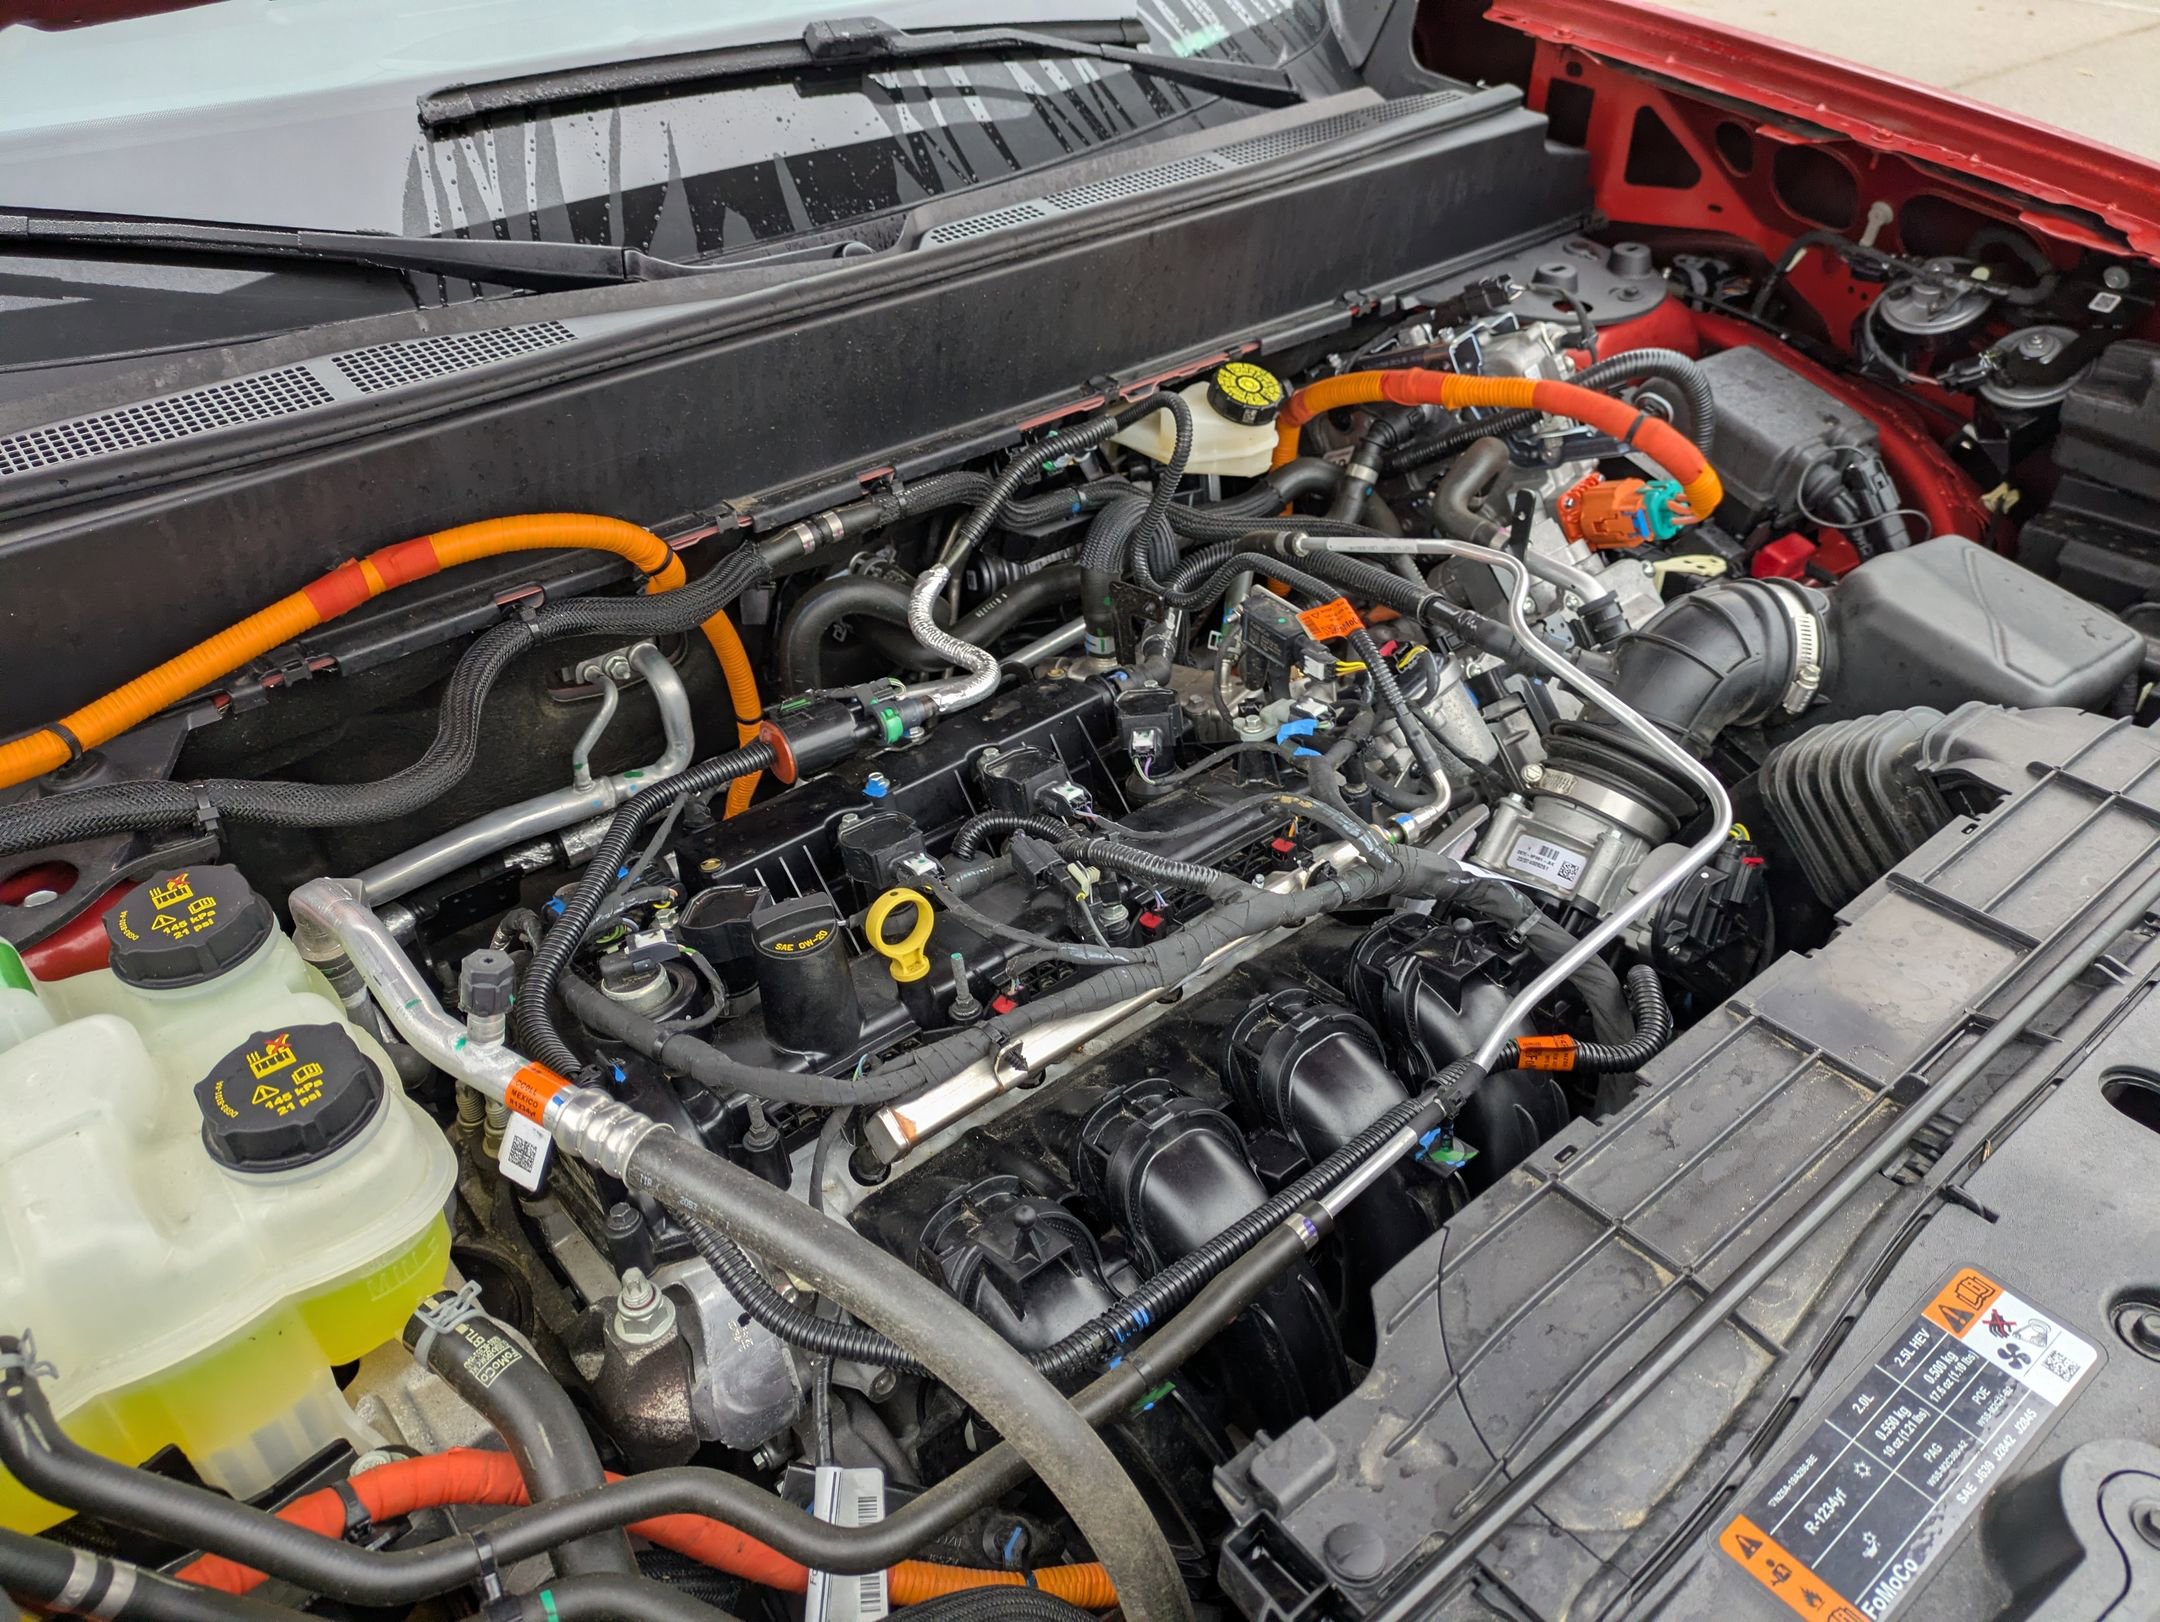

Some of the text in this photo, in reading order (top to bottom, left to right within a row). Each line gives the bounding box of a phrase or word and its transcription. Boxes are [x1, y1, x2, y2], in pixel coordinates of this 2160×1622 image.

[163, 910, 216, 935] 145 kPa
[173, 918, 214, 940] 21 psi
[774, 943, 794, 951] SAE
[265, 1079, 324, 1110] 145 kPa
[277, 1089, 322, 1117] 21 psi
[511, 1089, 538, 1108] MEXICO
[481, 1346, 519, 1382] FoMoCo
[1894, 1328, 1930, 1368] 2.5L HEV
[1923, 1351, 1959, 1385] 0.500 kg
[1929, 1350, 1980, 1403] 17.6 oz (1.10 lbs)
[1852, 1394, 1875, 1415] 2.0L
[1971, 1386, 1991, 1405] POE
[1874, 1405, 1912, 1441] 0.550 kg
[1883, 1446, 1896, 1458] 19
[1899, 1420, 1917, 1442] (1.21
[1914, 1407, 1931, 1426] lbs)
[1923, 1442, 1943, 1463] PAG
[1956, 1408, 2037, 1504] SAE J639 J2842 J2845
[1804, 1486, 1847, 1535] R-1234yf
[1861, 1558, 1918, 1620] FoMoCo
